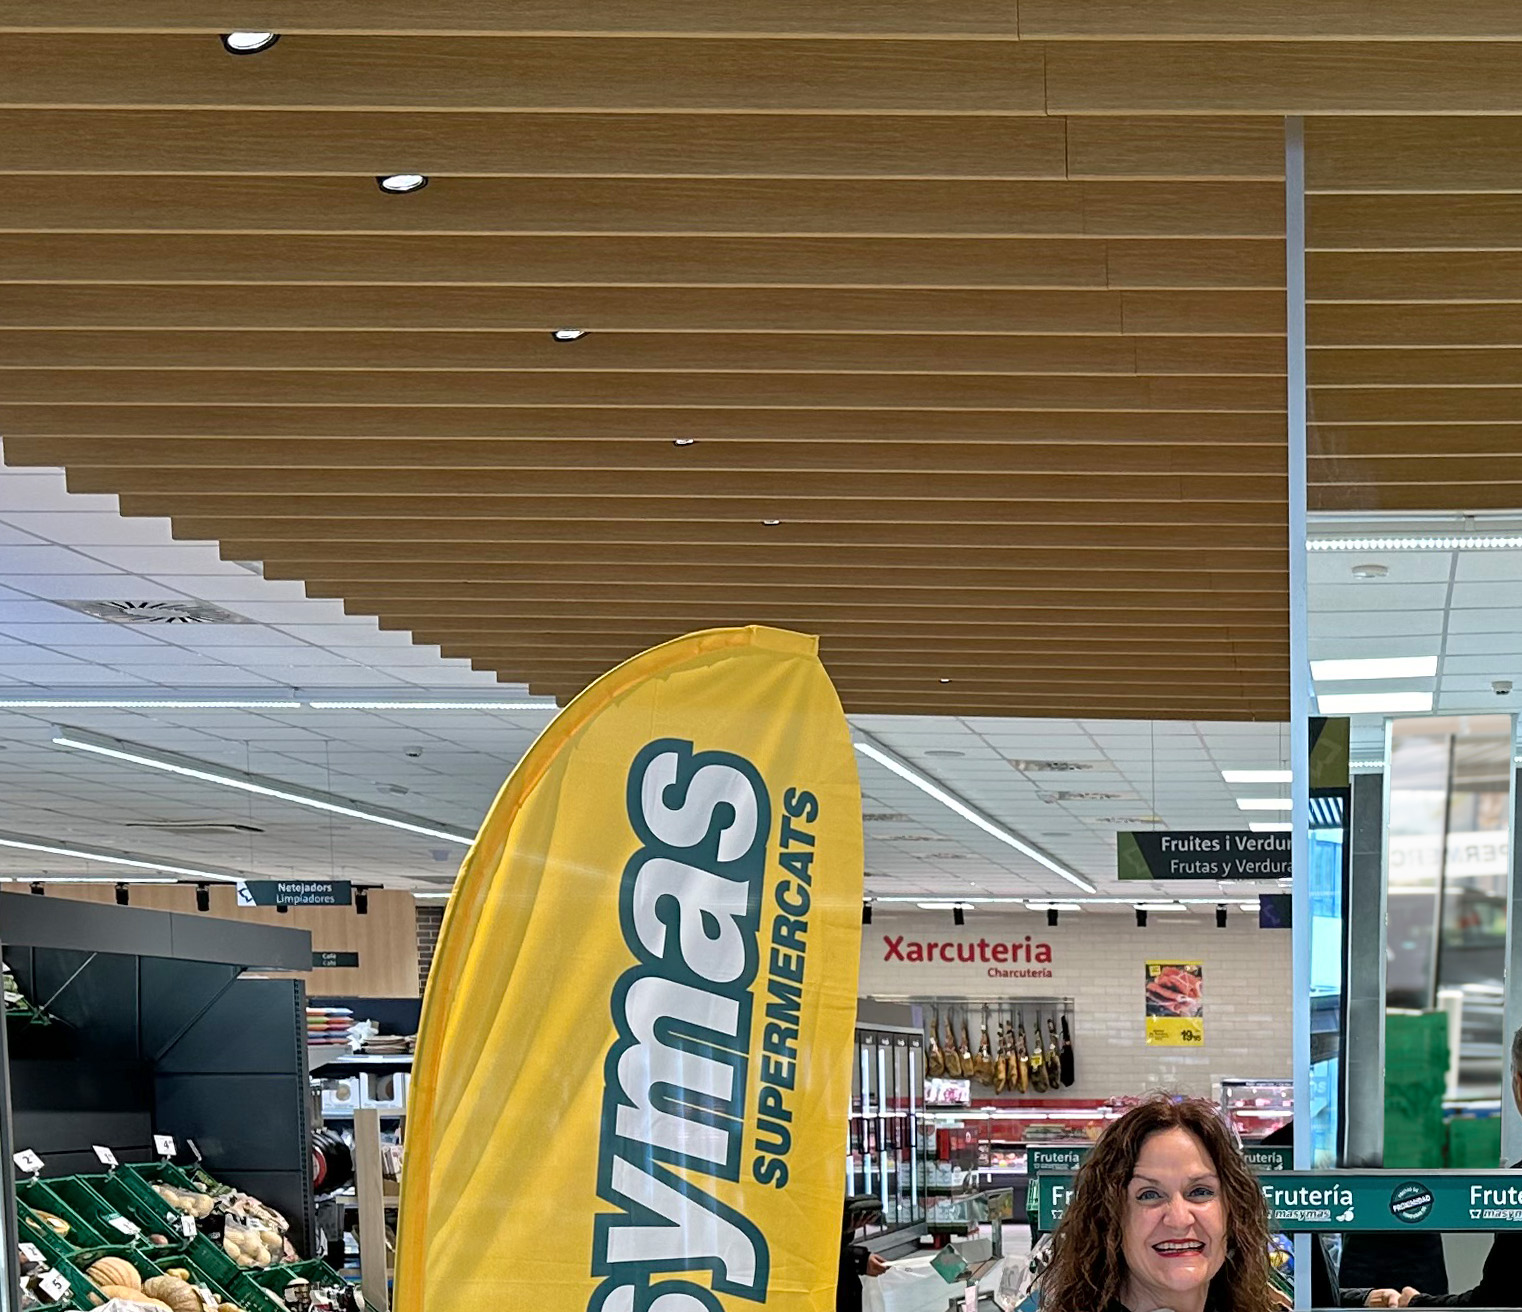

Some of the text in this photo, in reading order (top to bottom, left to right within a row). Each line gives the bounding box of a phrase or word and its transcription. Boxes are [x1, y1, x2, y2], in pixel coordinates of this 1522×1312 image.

[1161, 835, 1220, 852] Fruites
[1225, 835, 1230, 851] i
[1170, 859, 1219, 874] Frutas
[1221, 861, 1232, 878] y
[276, 894, 336, 906] Limpiadores
[883, 935, 1053, 963] Xarcuteria
[752, 787, 820, 1190] SUPERMERCATS
[1033, 1151, 1080, 1163] Frutería
[1261, 1183, 1353, 1206] Frutería
[1275, 1208, 1331, 1221] masymas
